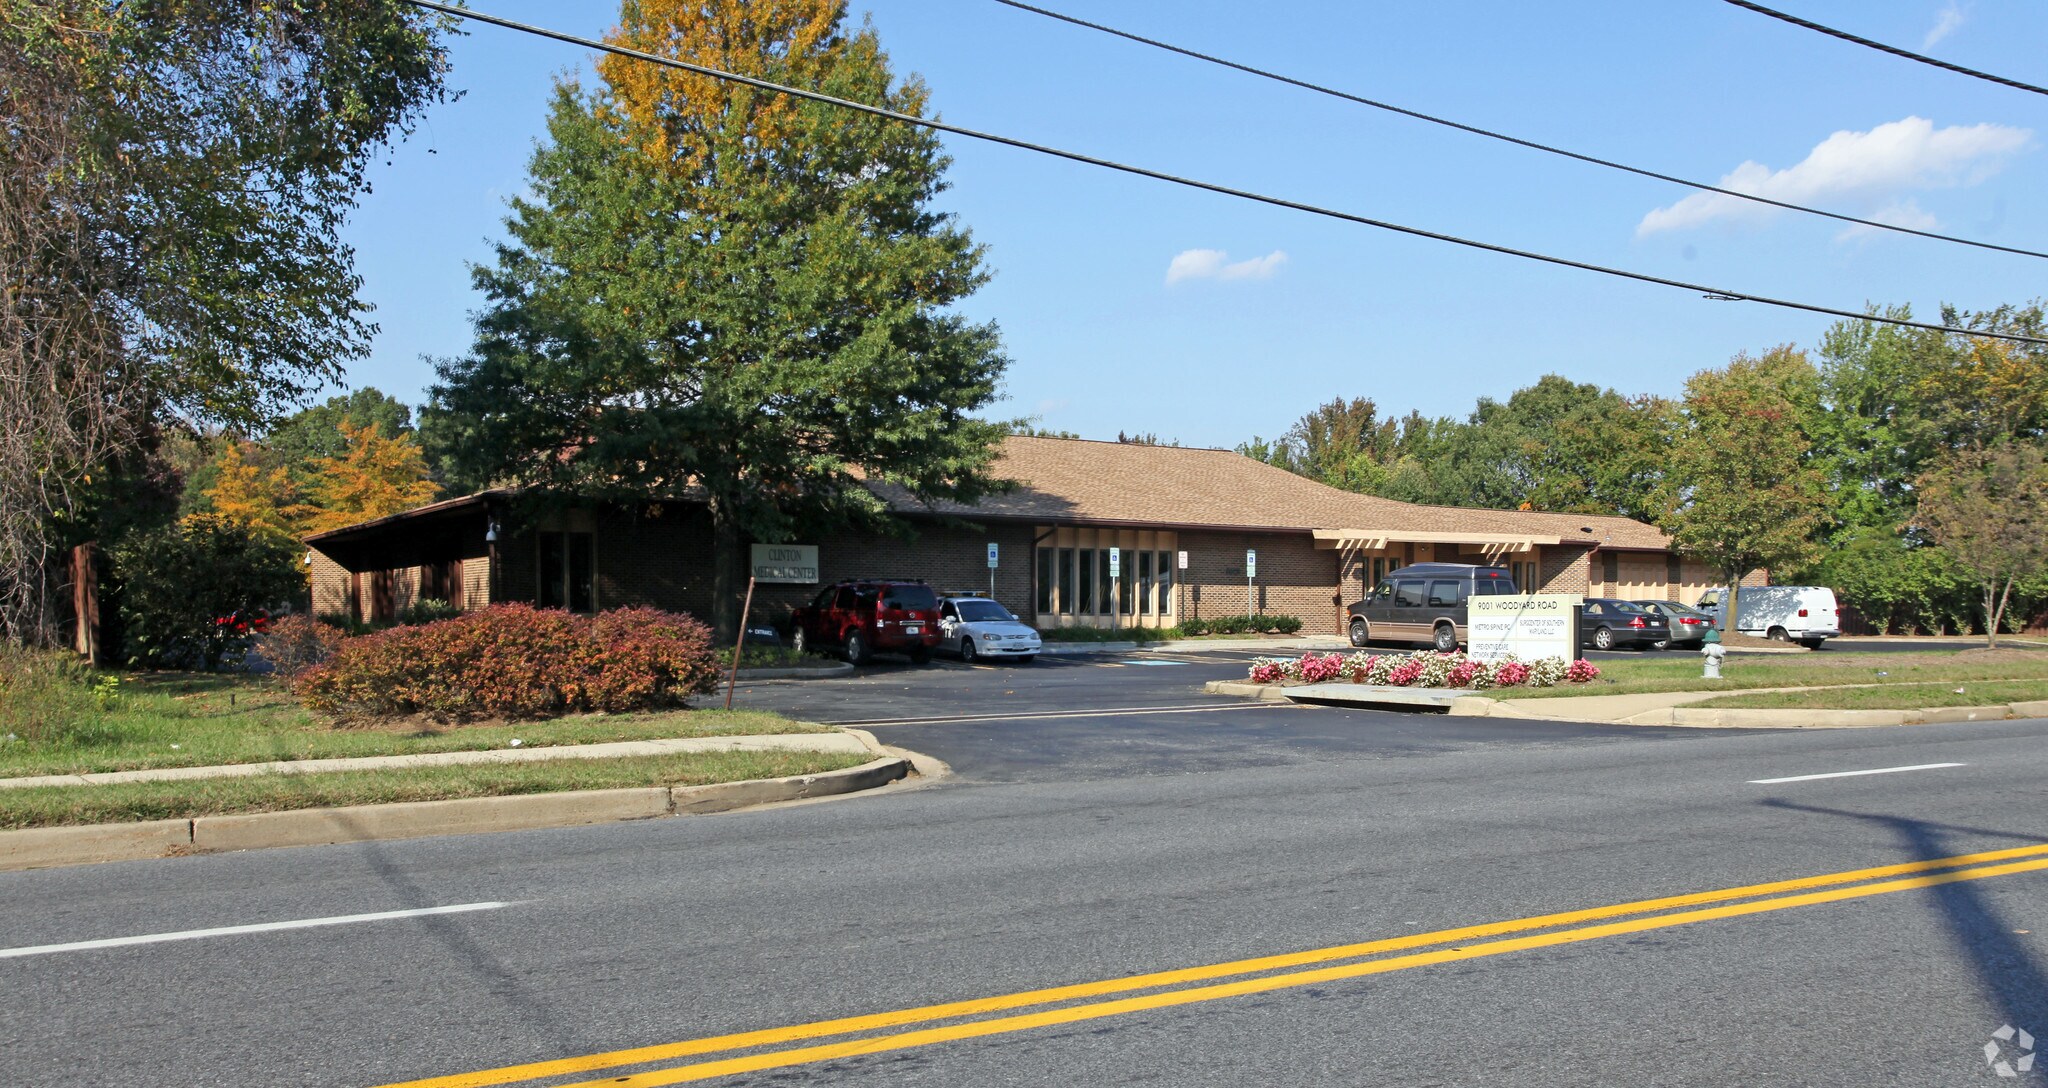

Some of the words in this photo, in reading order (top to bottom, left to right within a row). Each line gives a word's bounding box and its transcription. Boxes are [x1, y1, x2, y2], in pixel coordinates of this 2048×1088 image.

[768, 548, 802, 562] CLINTON
[754, 566, 786, 579] MEDICAL
[788, 567, 817, 579] CENTER
[1538, 601, 1558, 609] ROAD
